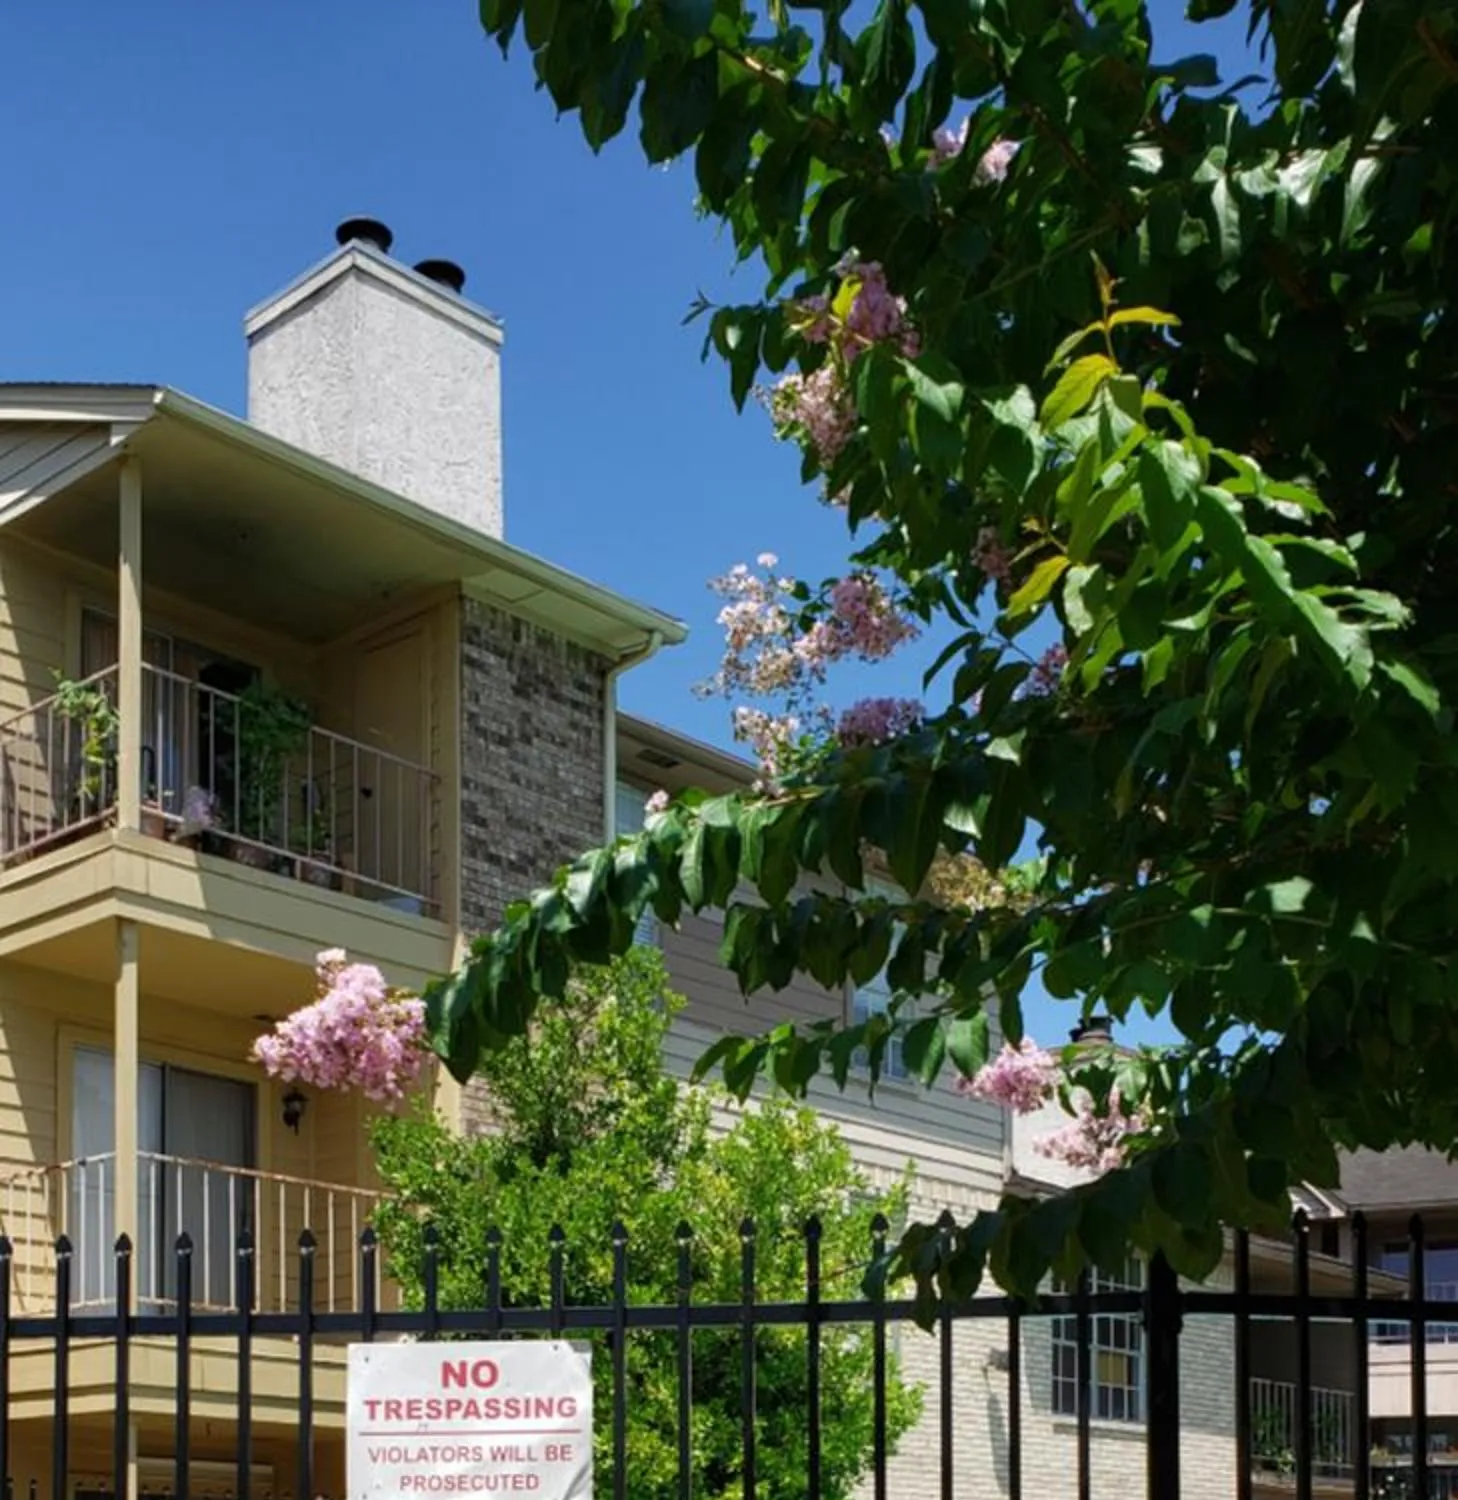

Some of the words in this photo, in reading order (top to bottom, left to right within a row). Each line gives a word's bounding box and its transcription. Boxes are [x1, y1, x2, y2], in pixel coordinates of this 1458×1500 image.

[441, 1360, 499, 1388] NO
[363, 1397, 577, 1421] TRESPASSING
[368, 1447, 483, 1464] VIOLATORS
[490, 1446, 538, 1462] WILL
[544, 1444, 573, 1461] BE
[399, 1473, 540, 1492] PROSECUTED
